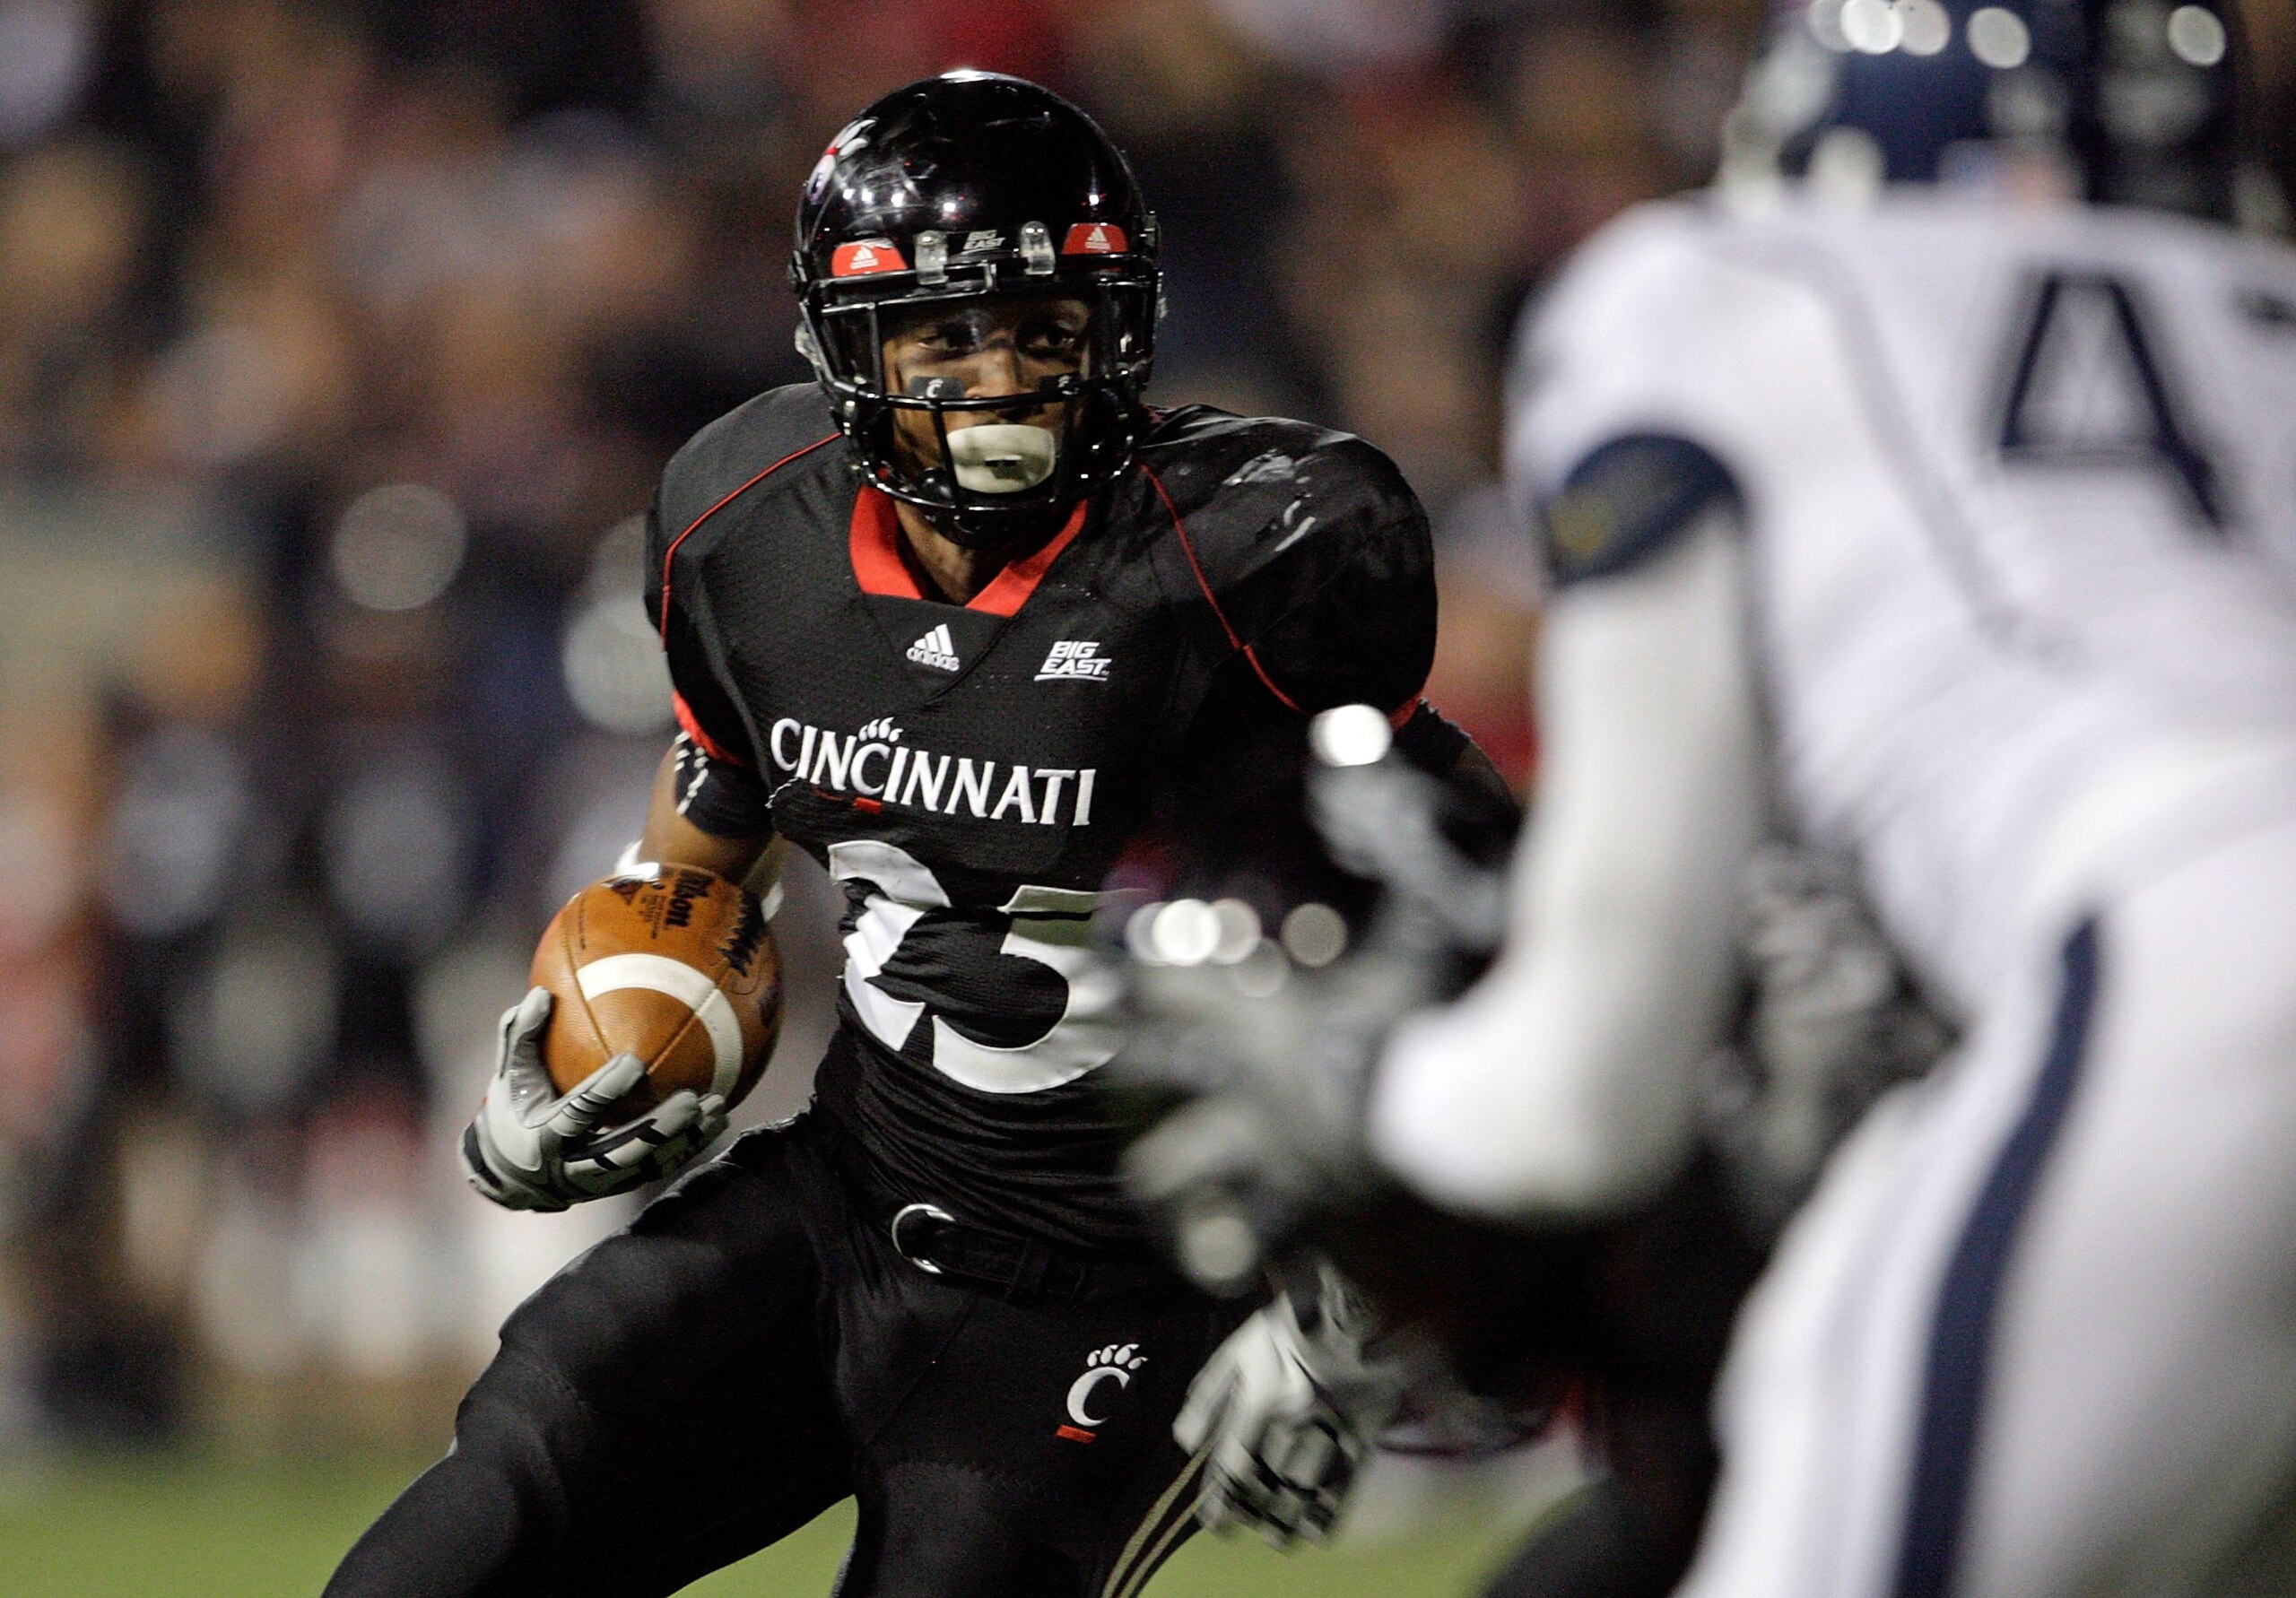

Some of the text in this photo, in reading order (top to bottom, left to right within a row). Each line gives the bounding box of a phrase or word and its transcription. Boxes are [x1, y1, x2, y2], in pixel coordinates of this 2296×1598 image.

[963, 238, 1006, 250] EAST
[906, 646, 961, 672] adidas
[1048, 640, 1100, 659] BIG
[1039, 658, 1112, 675] EAST
[770, 716, 1097, 826] CINCINNATI
